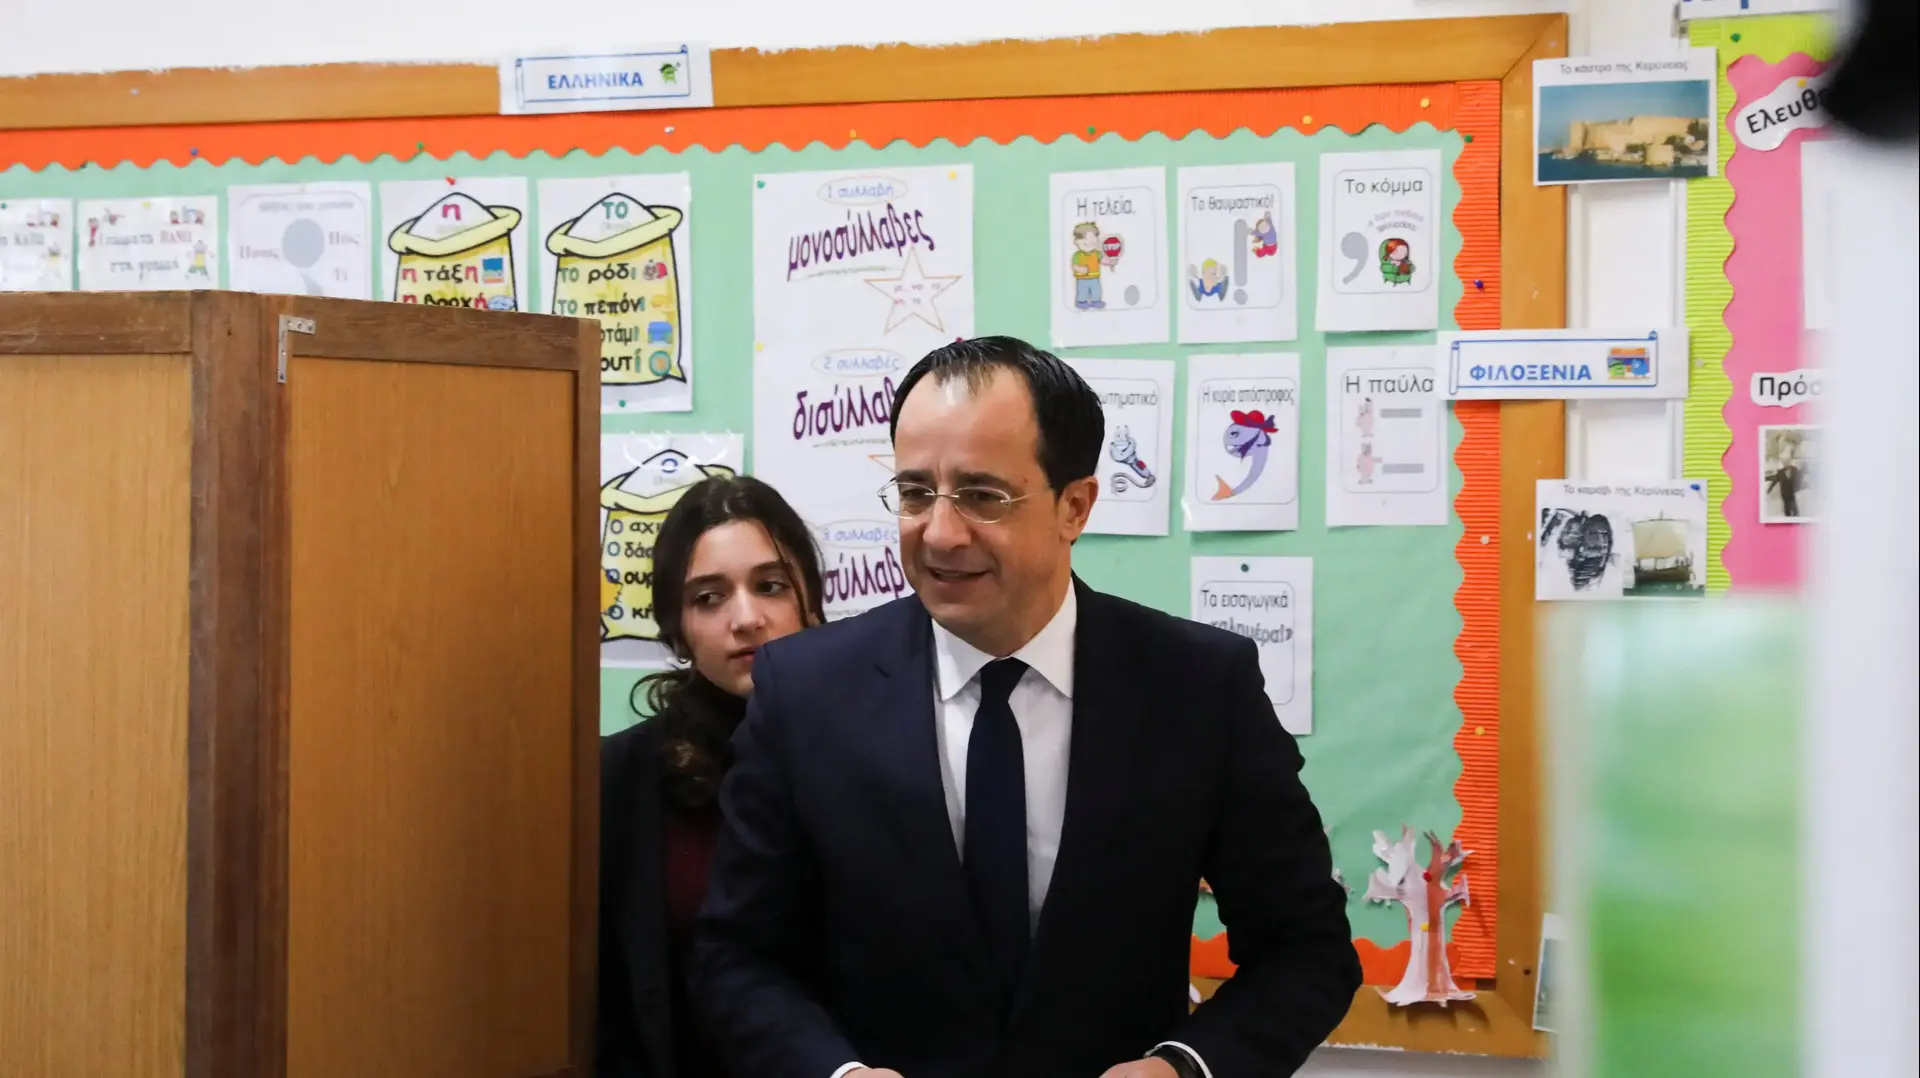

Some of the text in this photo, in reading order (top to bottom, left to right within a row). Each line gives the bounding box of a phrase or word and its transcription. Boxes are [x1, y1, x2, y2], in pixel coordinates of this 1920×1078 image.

[548, 72, 644, 89] ΕΛΛΗΝΙΚΑ
[1343, 177, 1423, 196] Το κόμμα
[442, 203, 461, 221] η
[1076, 198, 1087, 217] Η
[1191, 196, 1204, 211] Το
[787, 202, 935, 282] μονοσύλλαβες
[402, 263, 478, 285] η τάξη
[588, 262, 636, 284] ρόδι
[584, 292, 645, 316] πεπόνι
[1469, 364, 1592, 382] ΦΙΛΟΞΕΝΙΑ
[1346, 374, 1435, 394] Η παύλα
[1201, 589, 1288, 612] Τα εισαγωγικά
